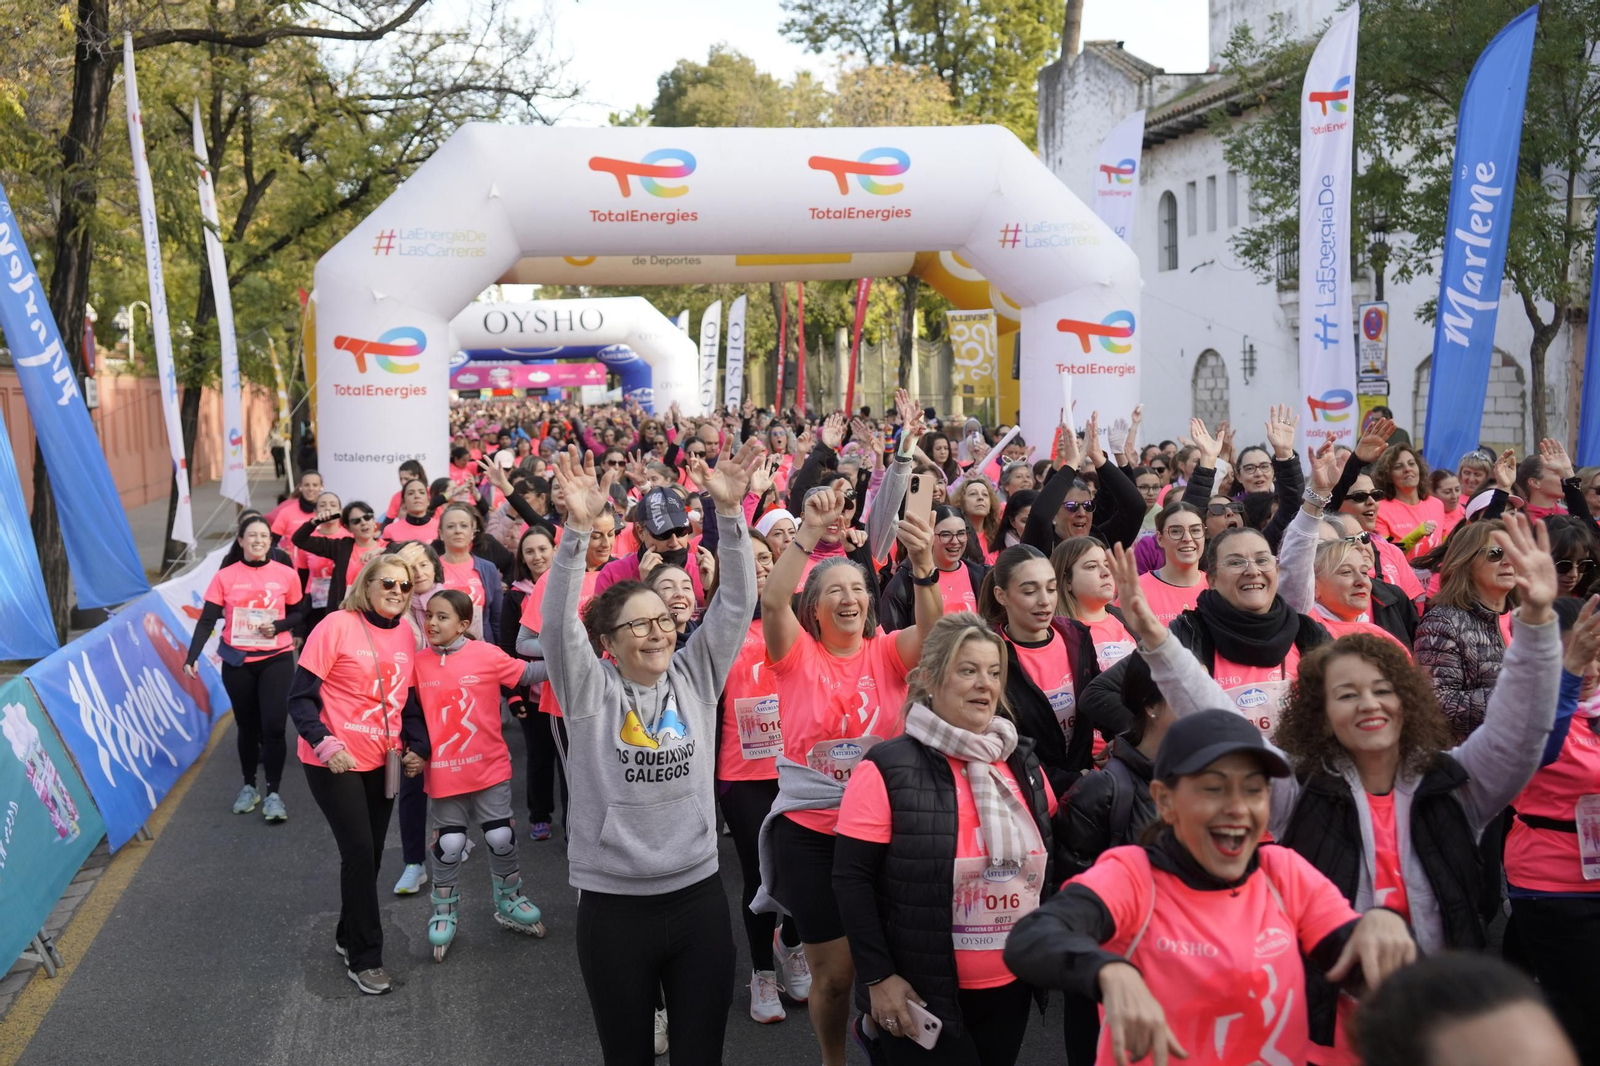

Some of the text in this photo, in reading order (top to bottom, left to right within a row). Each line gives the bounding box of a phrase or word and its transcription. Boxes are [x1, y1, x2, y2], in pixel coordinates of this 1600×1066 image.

[589, 208, 698, 225] TotalEnergies
[808, 205, 912, 222] TotalEnergies
[399, 243, 487, 258] LasCarreras
[1442, 160, 1502, 348] Marlene
[632, 256, 702, 267] de Deportes
[483, 308, 604, 335] OYSHO
[701, 321, 717, 407] OYSHO
[1056, 363, 1136, 377] TotalEnergies
[333, 384, 427, 399] TotalEnergies
[1218, 676, 1242, 686] SHO
[756, 704, 779, 712] ASTURIAN
[1051, 697, 1072, 708] STURIANA
[68, 632, 193, 811] Marlene
[1060, 716, 1076, 731] 16
[635, 739, 696, 766] QUEIXIÑO
[430, 759, 449, 768] RRERA
[624, 762, 690, 783] GALEGOS
[834, 768, 852, 780] 01
[985, 892, 1020, 910] 016
[994, 915, 1012, 924] 6073
[961, 936, 994, 945] OYSHO
[1156, 936, 1219, 958] OYSHO
